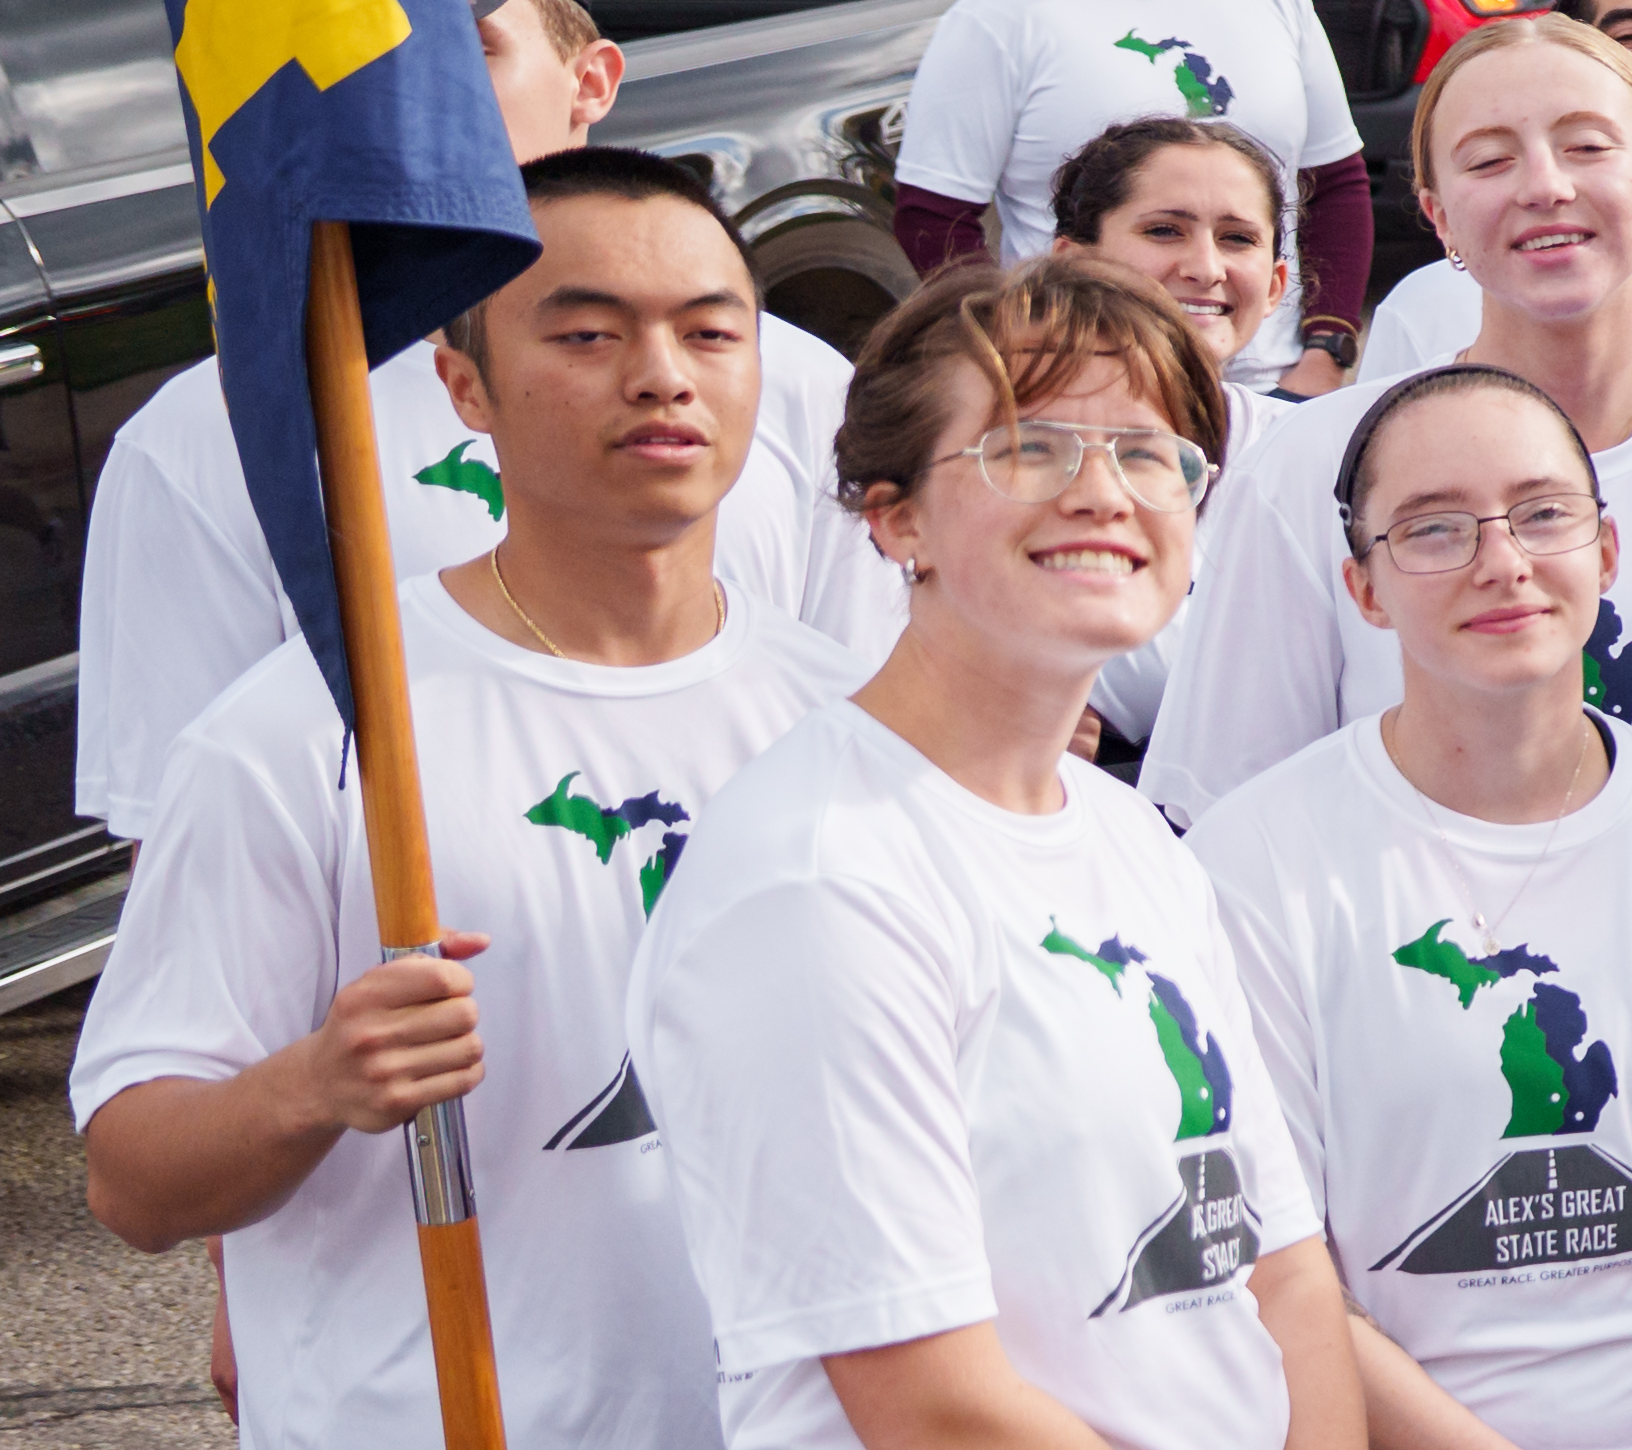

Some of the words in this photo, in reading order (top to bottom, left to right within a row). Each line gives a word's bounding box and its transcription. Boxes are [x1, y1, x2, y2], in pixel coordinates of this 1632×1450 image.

[1207, 1193, 1242, 1234] GREAT
[1485, 1193, 1554, 1227] ALEX'S
[1562, 1185, 1627, 1218] GREAT
[1496, 1229, 1558, 1263] STATE
[1566, 1223, 1618, 1254] RACE
[1458, 1276, 1497, 1289] GREAT
[1540, 1267, 1590, 1281] GREATER
[1166, 1297, 1203, 1314] GREAT
